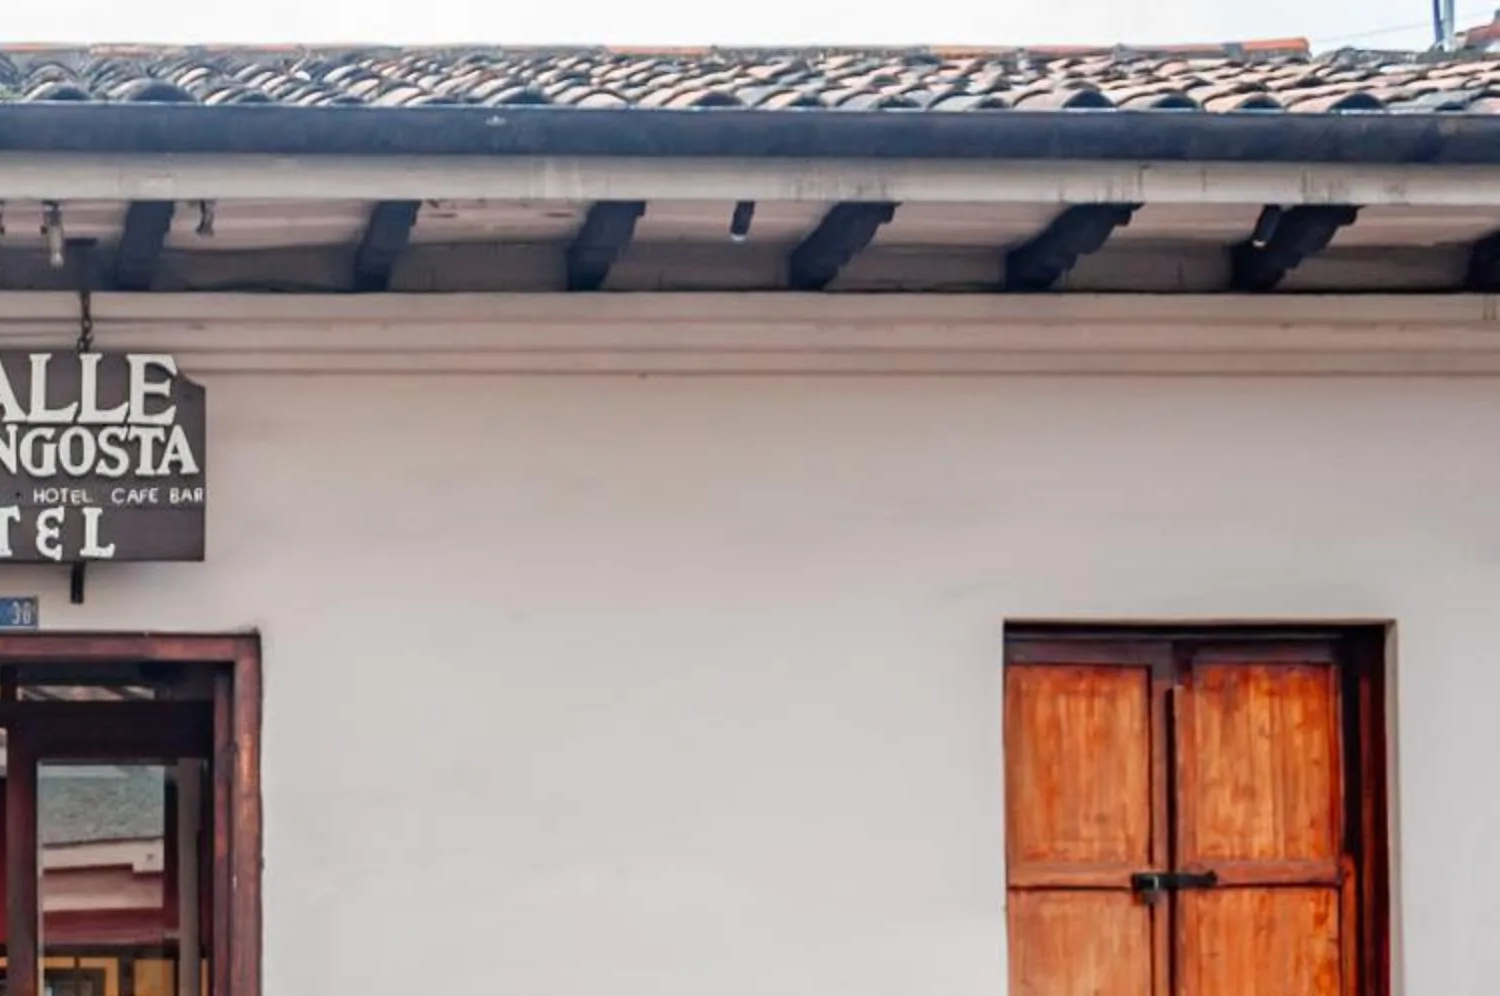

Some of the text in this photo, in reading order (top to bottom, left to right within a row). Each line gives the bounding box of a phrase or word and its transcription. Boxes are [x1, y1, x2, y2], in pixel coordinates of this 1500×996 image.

[33, 487, 203, 505] HOTEL CAFE BAR
